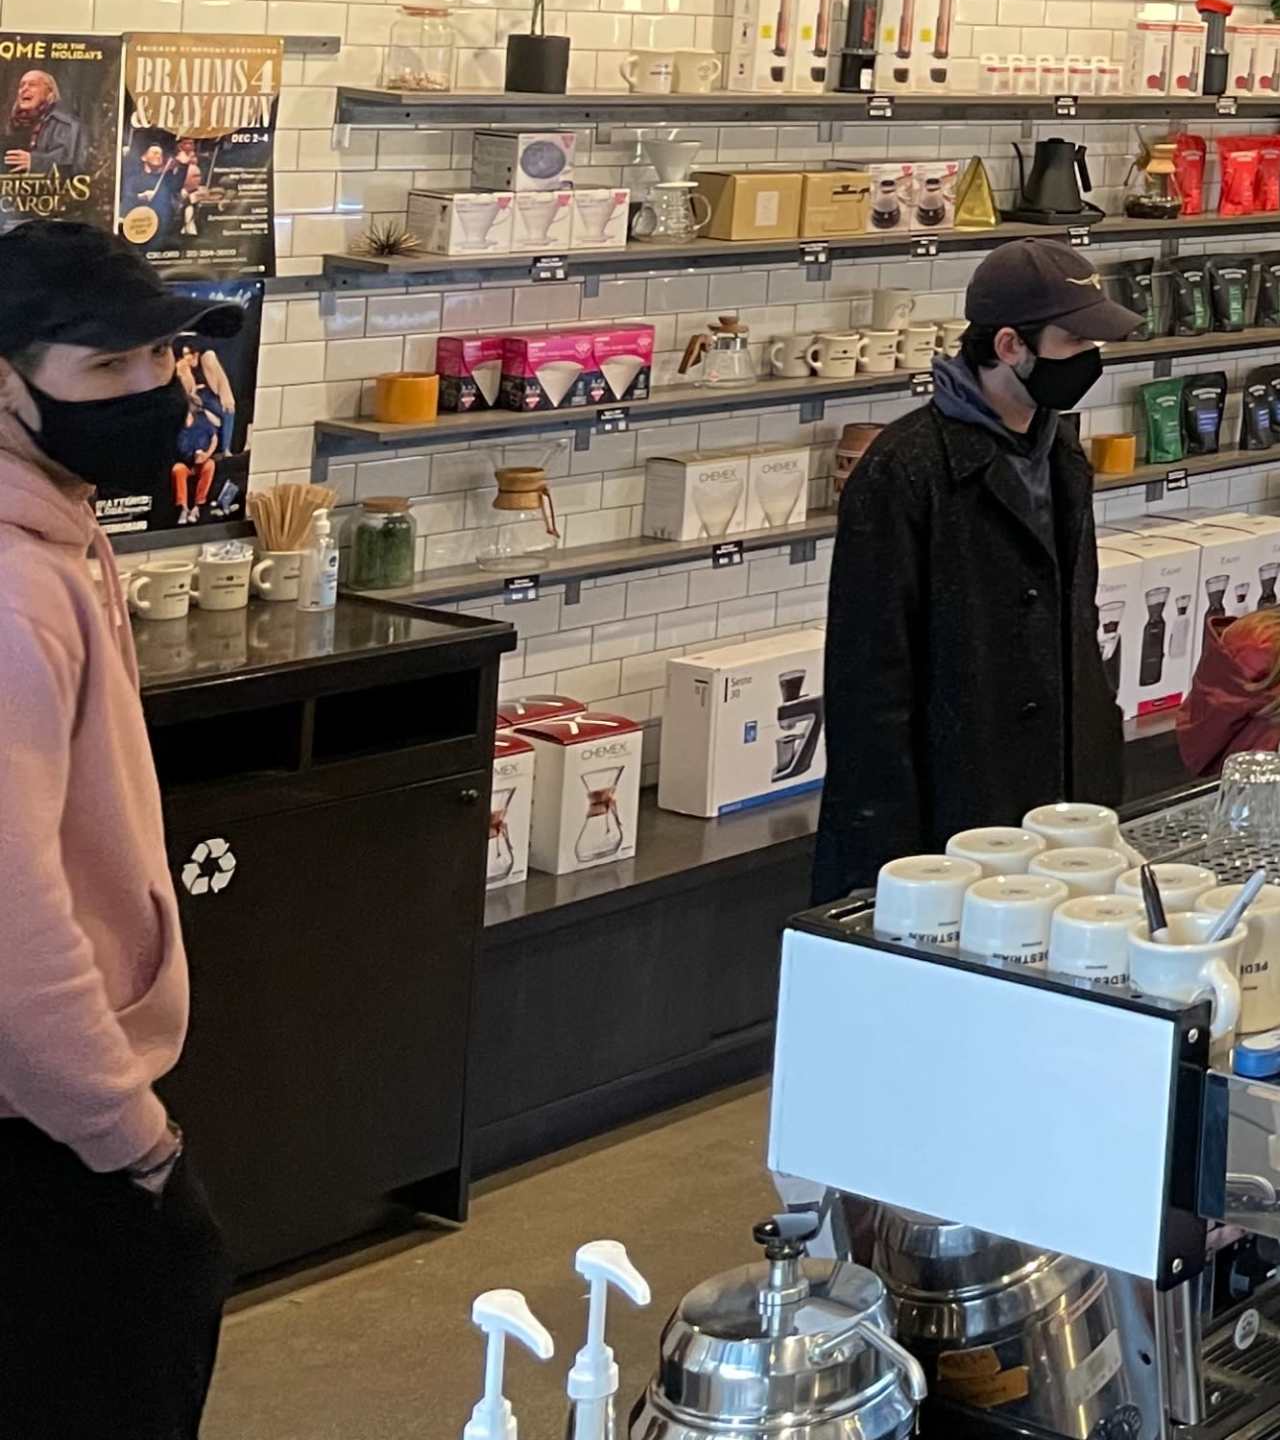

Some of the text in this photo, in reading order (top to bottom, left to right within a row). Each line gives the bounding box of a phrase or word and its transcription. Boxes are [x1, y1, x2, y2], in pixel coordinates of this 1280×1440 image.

[51, 50, 103, 60] HOLIDAYS
[136, 57, 275, 93] BRAHMS 4
[131, 95, 273, 131] & RAY CHEN
[231, 133, 250, 143] DEC
[581, 744, 628, 761] CHEMEX
